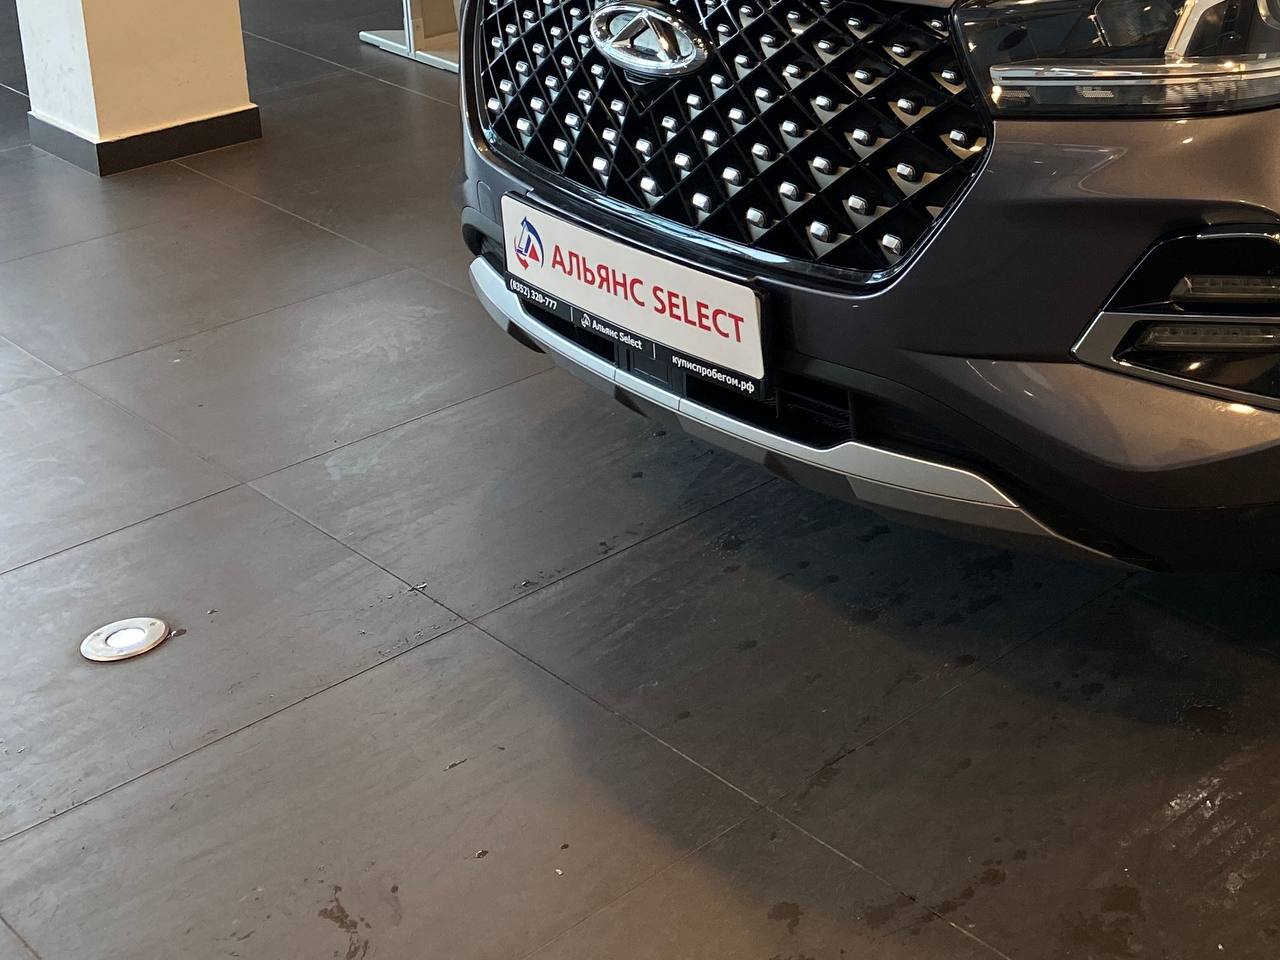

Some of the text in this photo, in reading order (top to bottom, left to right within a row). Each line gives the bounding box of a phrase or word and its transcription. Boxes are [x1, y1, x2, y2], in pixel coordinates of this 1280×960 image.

[509, 278, 558, 311] (8352) 320-777
[551, 244, 745, 343] АЛЬЯНС SELECT
[591, 320, 643, 350] Альянс Select
[671, 355, 755, 394] куписпробегом.рф
